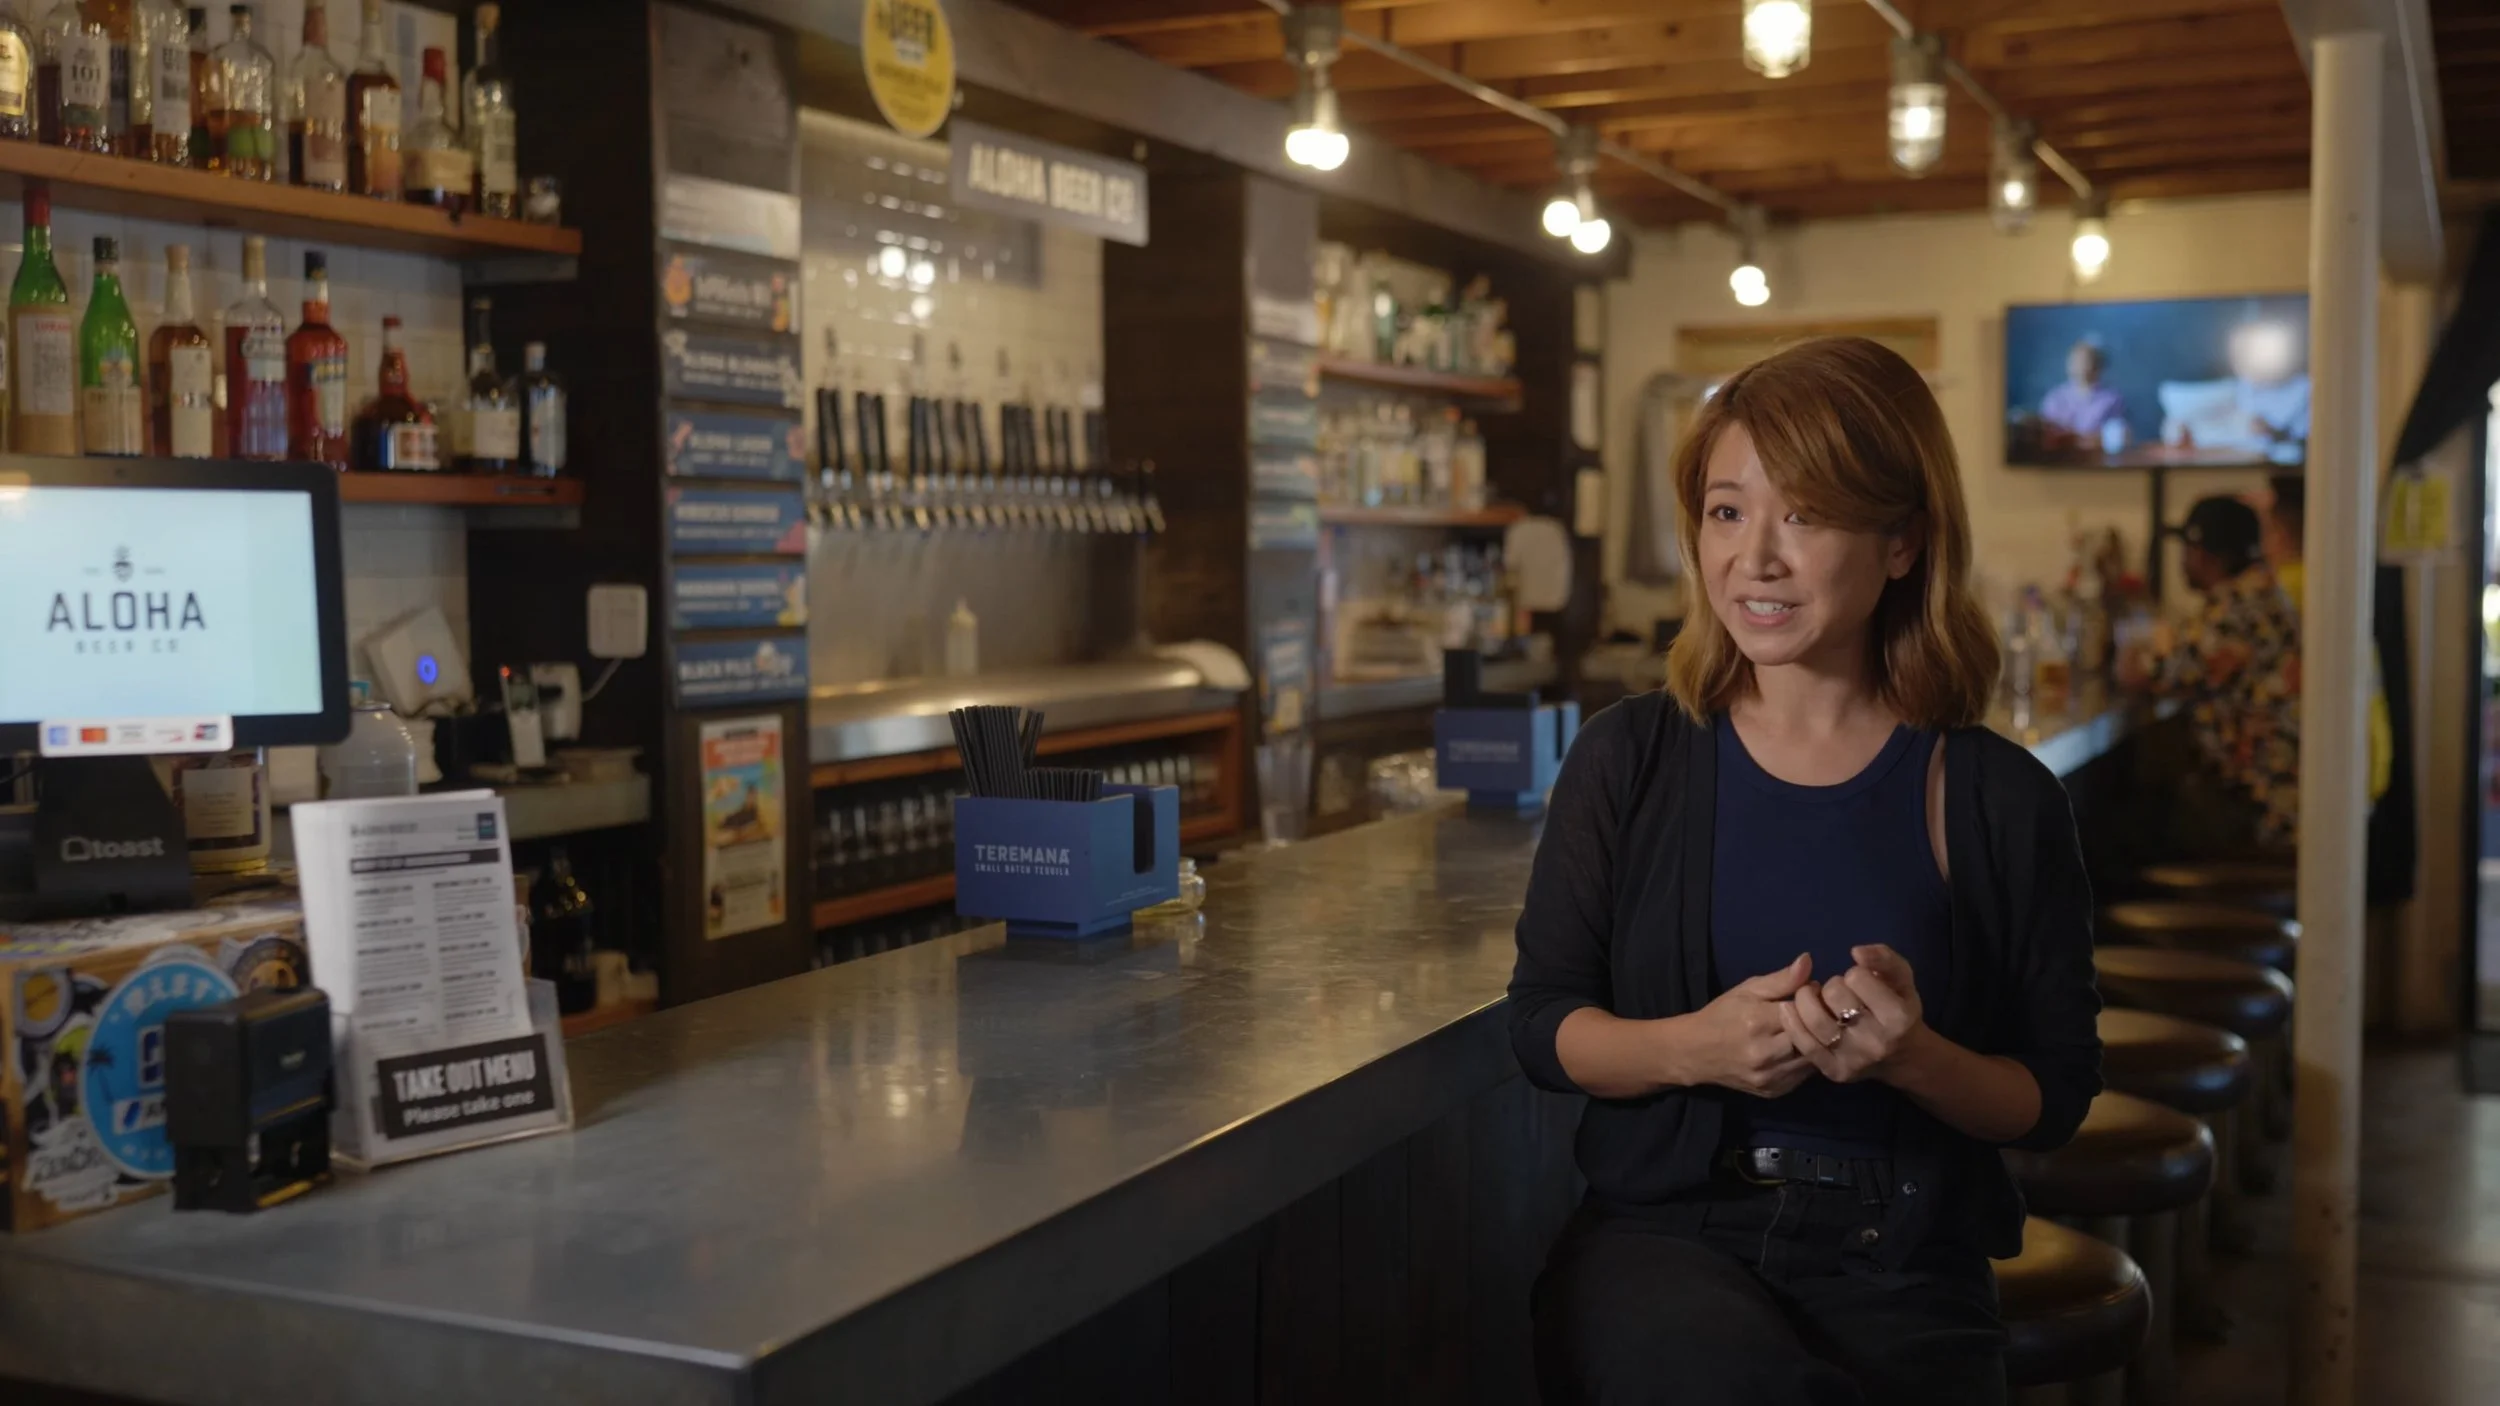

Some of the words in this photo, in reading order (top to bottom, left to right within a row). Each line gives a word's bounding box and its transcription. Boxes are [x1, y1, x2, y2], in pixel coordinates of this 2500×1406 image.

[968, 142, 1047, 204] ALOHA
[1050, 161, 1104, 216] BEER
[47, 591, 205, 632] ALOHA
[74, 638, 134, 654] BEER
[91, 836, 165, 859] toast
[974, 862, 1001, 873] SMALL
[1004, 863, 1031, 875] BATCH
[1034, 865, 1070, 876] TEQUILA
[392, 1064, 447, 1103] TAKE
[446, 1058, 483, 1094] OUT
[483, 1050, 537, 1087] MENU
[402, 1103, 461, 1128] Please
[461, 1095, 501, 1117] take
[502, 1090, 535, 1109] one
